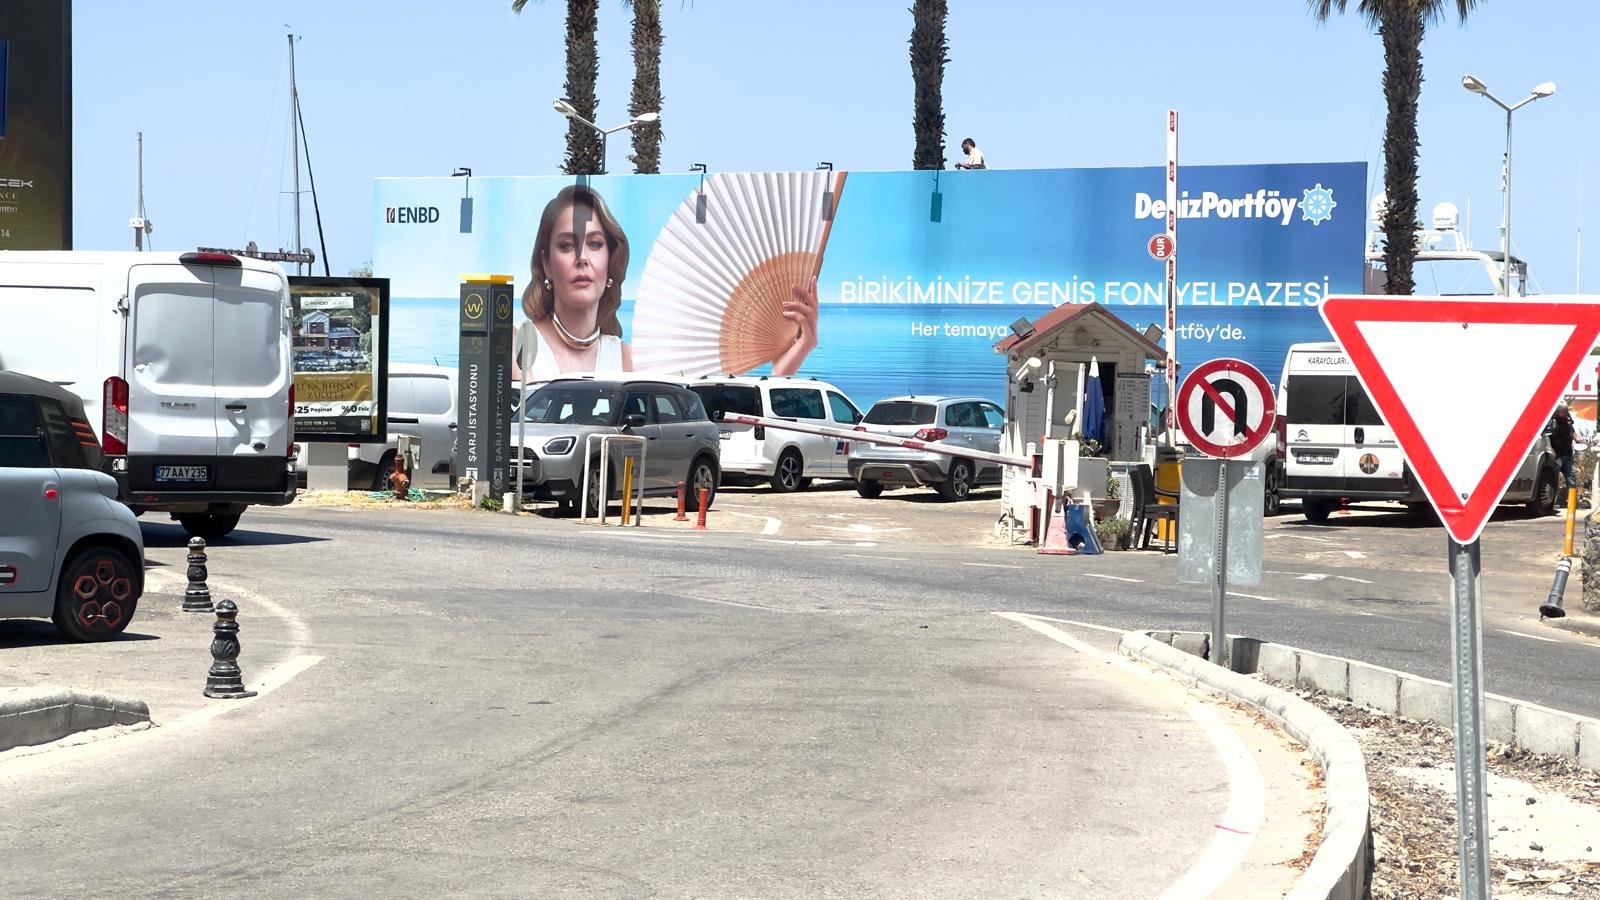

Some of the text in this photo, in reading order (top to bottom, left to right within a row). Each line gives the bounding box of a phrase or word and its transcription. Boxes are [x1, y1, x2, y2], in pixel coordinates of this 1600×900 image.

[398, 206, 440, 224] ENBD
[1156, 237, 1165, 257] DUR
[840, 274, 1005, 305] BİRİKİMİNİZE
[1104, 281, 1163, 305] FON
[1175, 275, 1329, 306] YELPAZESİ
[911, 321, 940, 336] Her
[943, 323, 1008, 339] temaya
[341, 405, 358, 414] %0
[467, 364, 478, 462] ŞARJ İSTASYONU
